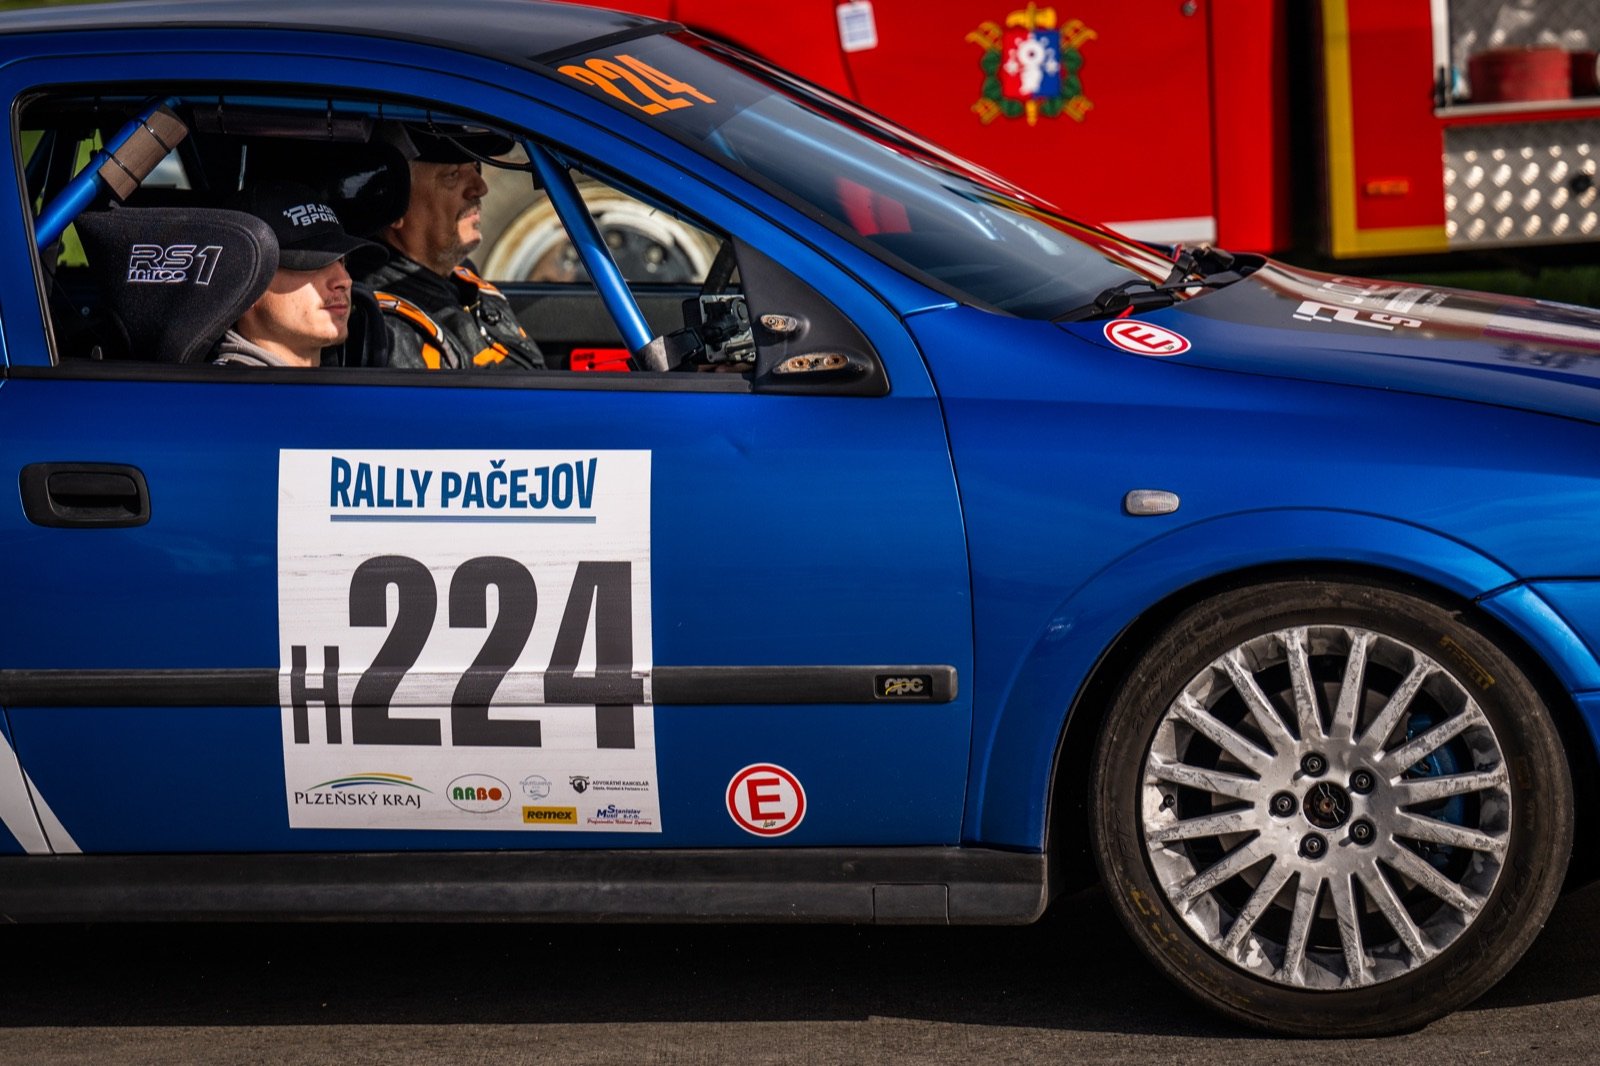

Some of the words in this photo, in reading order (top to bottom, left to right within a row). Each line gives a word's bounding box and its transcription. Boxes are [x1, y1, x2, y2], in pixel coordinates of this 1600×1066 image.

[556, 54, 717, 116] 224
[126, 267, 189, 283] mirco
[129, 244, 223, 286] RS1
[1116, 325, 1175, 349] E
[330, 456, 433, 508] RALLY
[440, 457, 598, 510] PAČEJOV
[294, 791, 378, 806] PLZEŇSKÝ
[383, 794, 421, 809] KRAJ
[452, 786, 503, 801] ARBO
[746, 777, 786, 821] E
